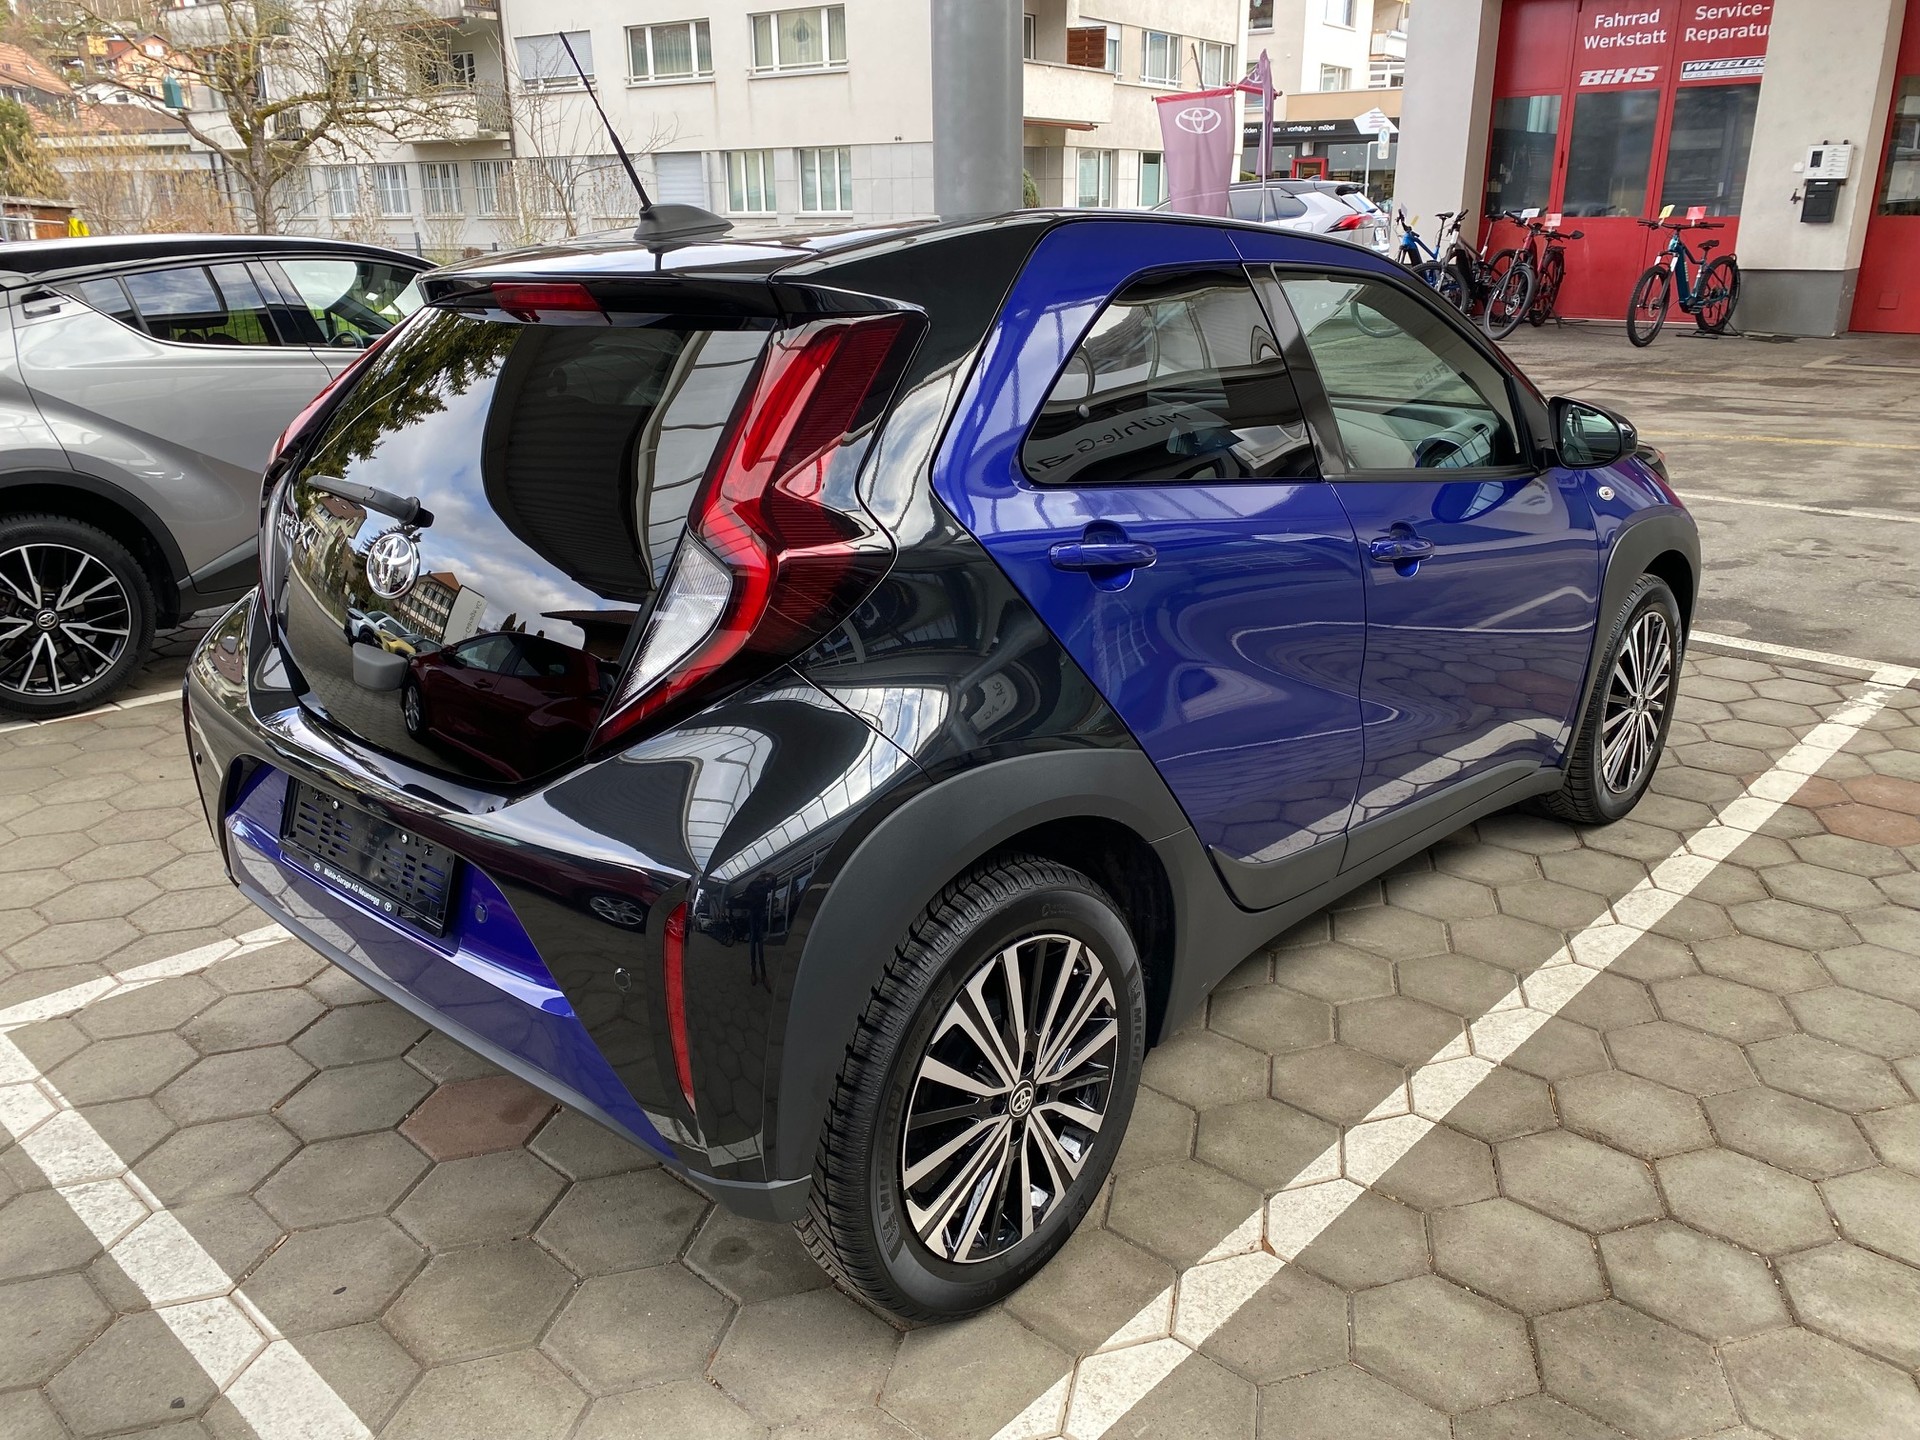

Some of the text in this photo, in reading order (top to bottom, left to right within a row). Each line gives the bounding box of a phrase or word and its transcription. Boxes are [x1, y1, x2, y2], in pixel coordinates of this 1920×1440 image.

[1594, 9, 1660, 29] Fahrrad
[1695, 2, 1771, 21] Service-
[1584, 29, 1667, 50] Werkstatt
[1685, 68, 1765, 78] WORLDWID
[350, 883, 359, 893] AG
